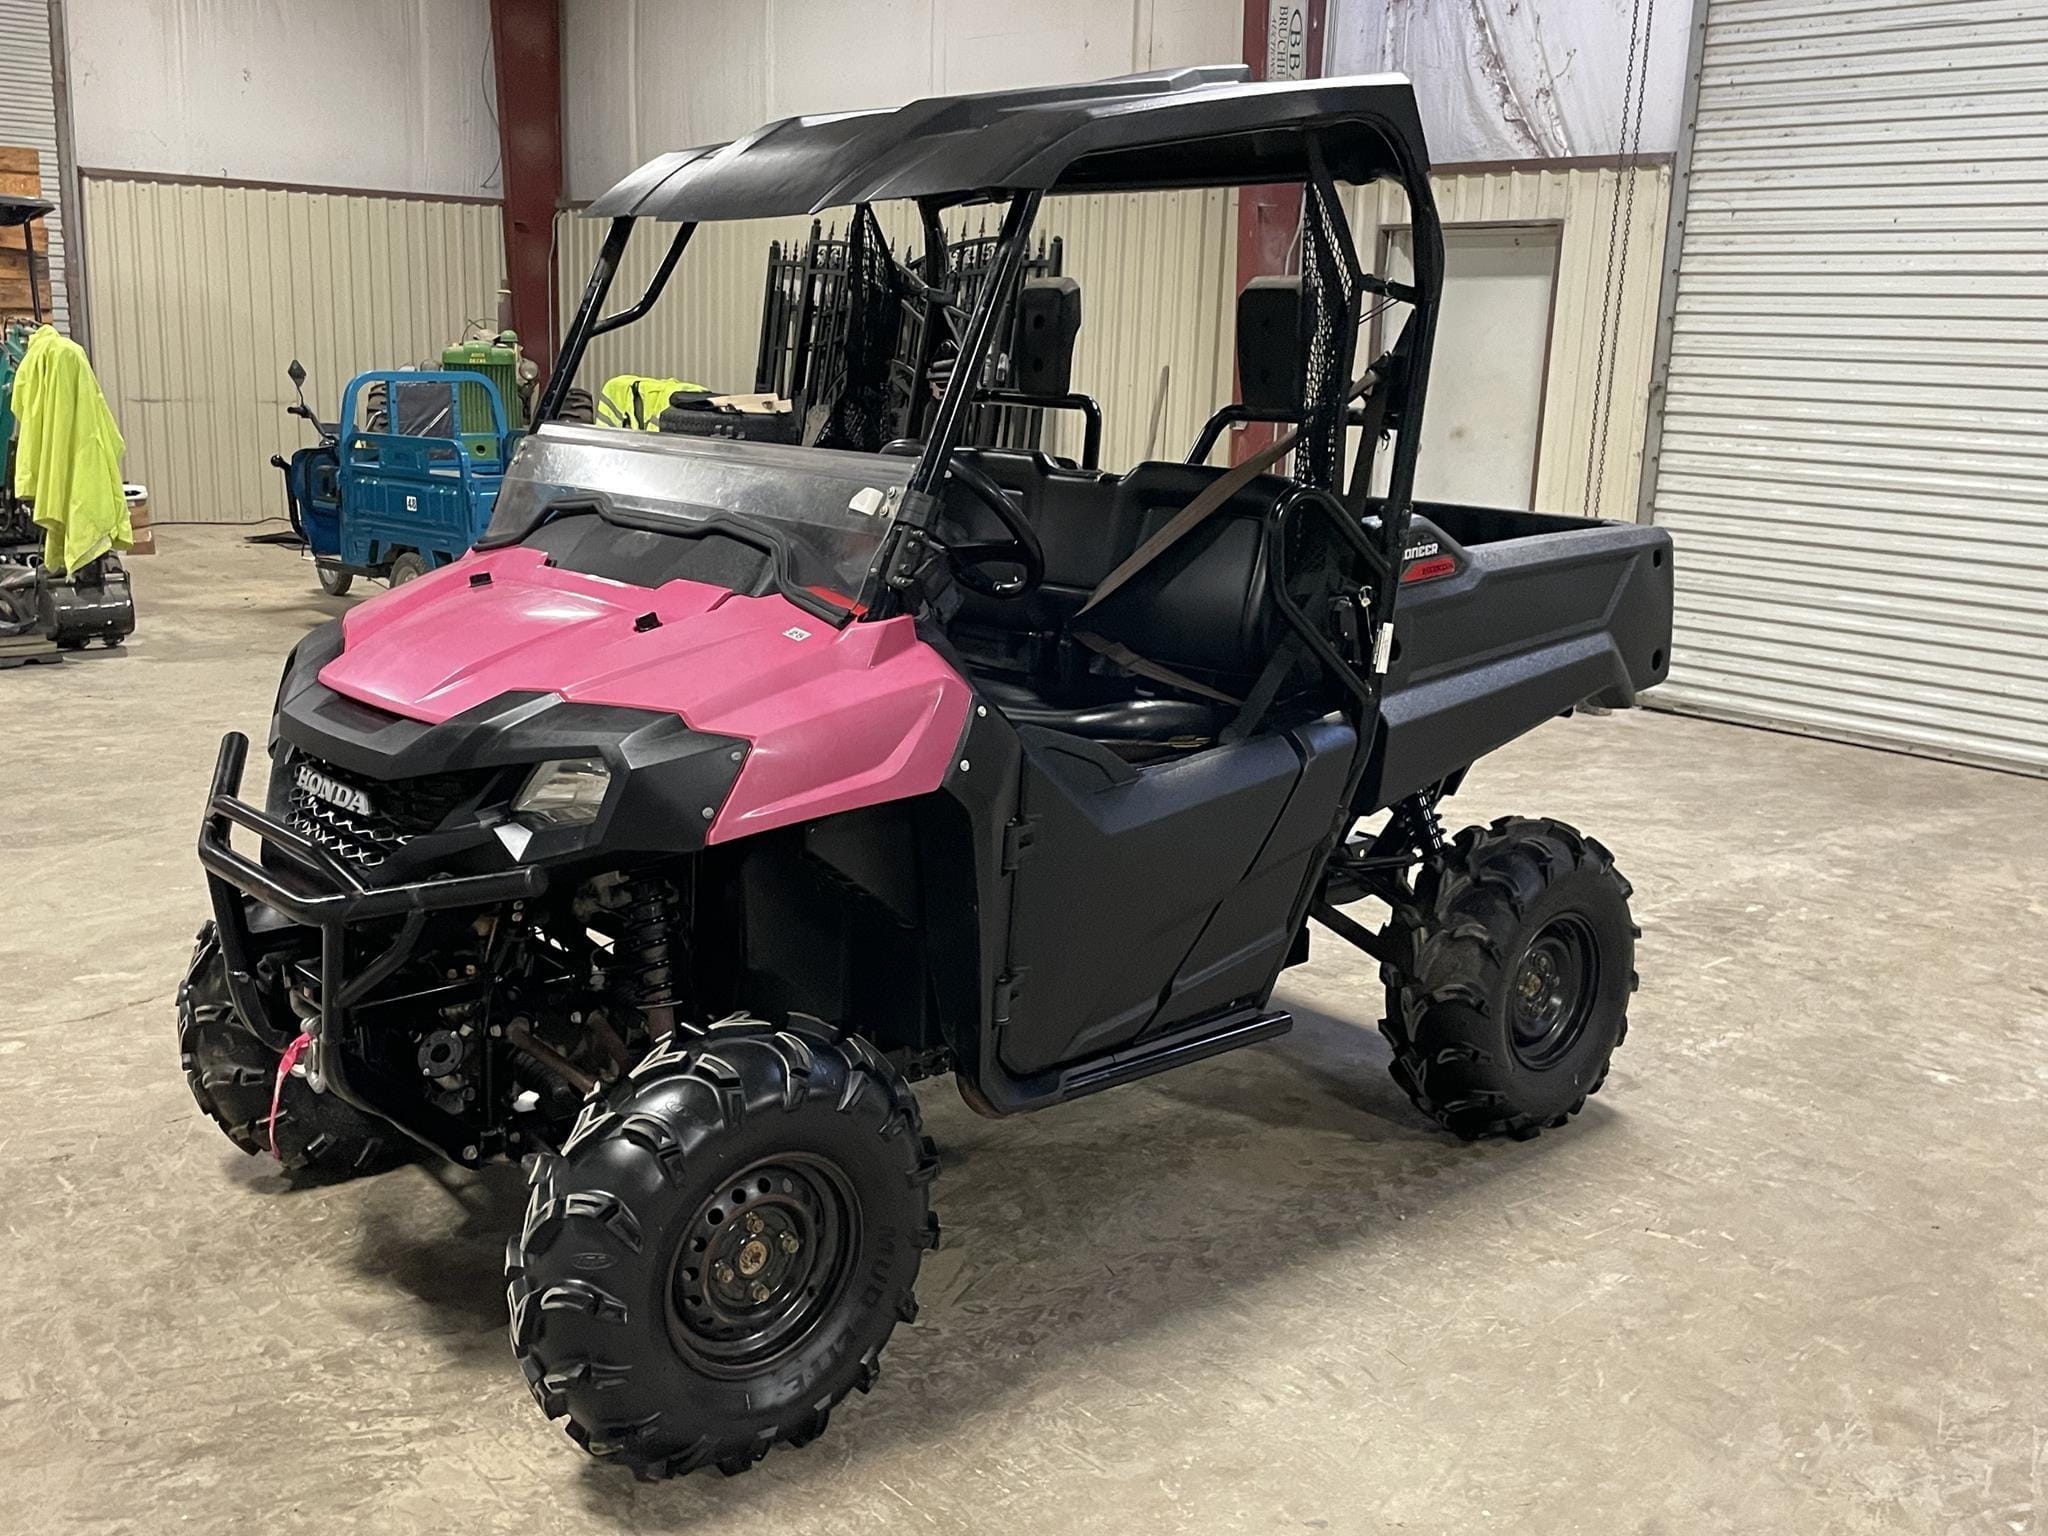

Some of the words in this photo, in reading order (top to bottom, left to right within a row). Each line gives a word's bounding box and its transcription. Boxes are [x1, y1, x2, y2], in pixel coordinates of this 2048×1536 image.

[1276, 6, 1289, 79] BRUCHH
[1403, 543, 1439, 560] ONEER
[297, 766, 371, 816] HONDA
